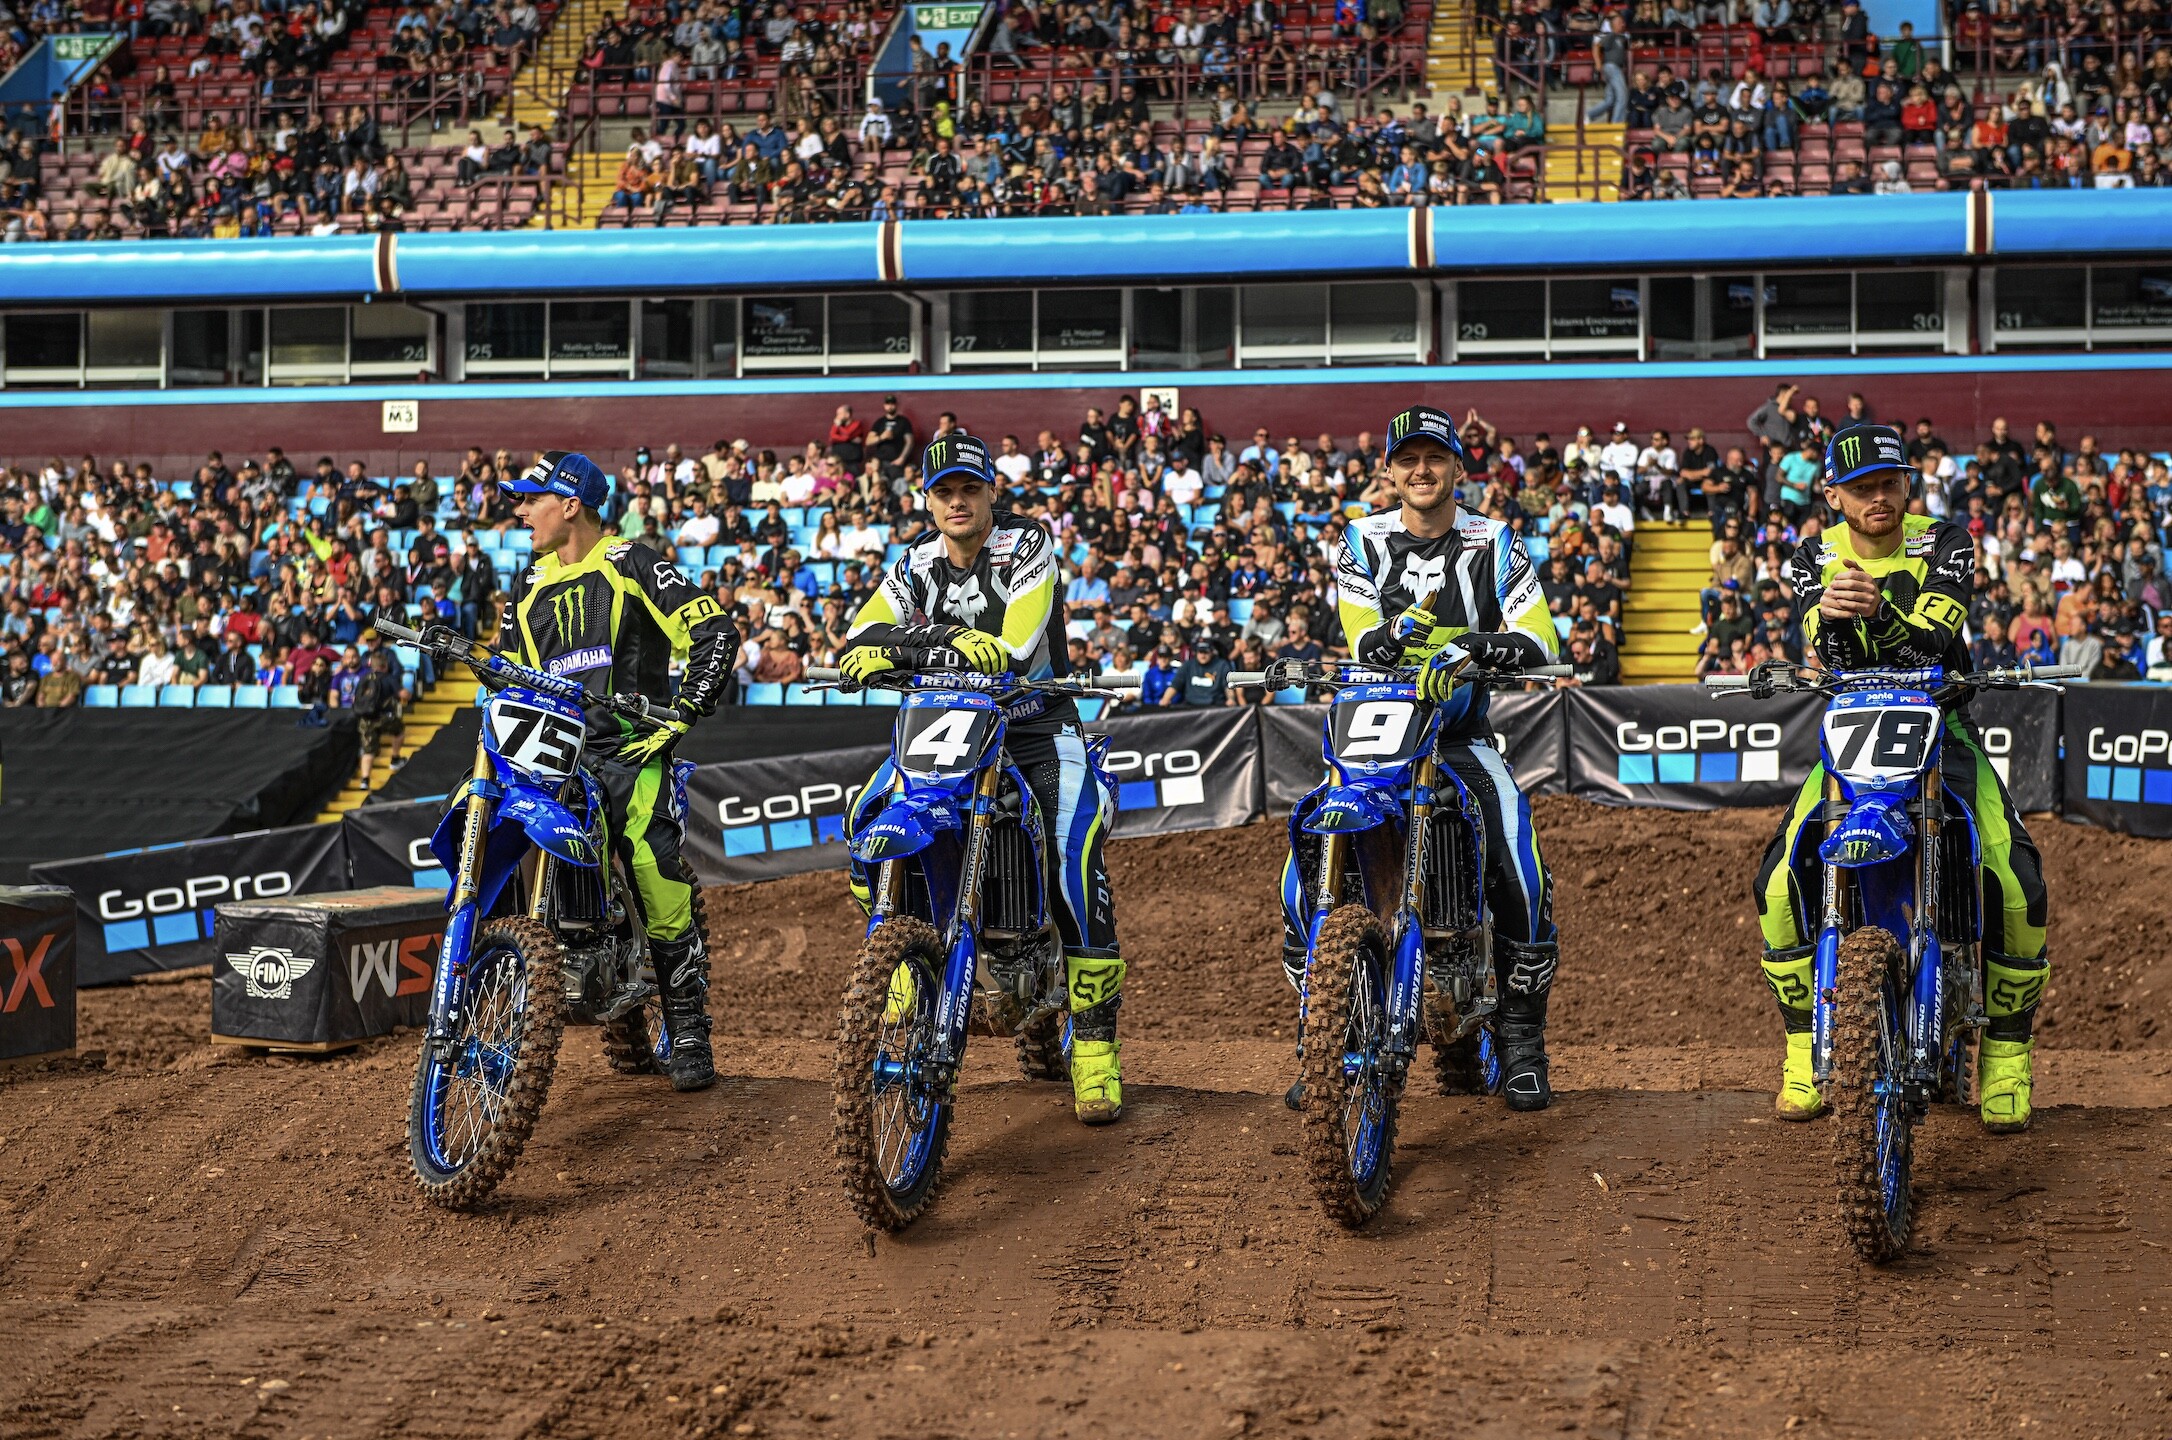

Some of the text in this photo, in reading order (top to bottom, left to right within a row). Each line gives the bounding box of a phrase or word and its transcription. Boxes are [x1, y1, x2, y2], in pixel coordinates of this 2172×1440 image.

[949, 10, 980, 24] EXIT
[1914, 313, 1941, 330] 30
[2000, 312, 2022, 328] 31
[1461, 323, 1487, 340] 29
[469, 343, 494, 359] 25
[885, 337, 909, 352] 26
[953, 336, 977, 351] 27
[402, 345, 426, 361] 24
[1426, 412, 1450, 426] YAMAHA
[962, 443, 985, 456] YAMAHA
[565, 473, 579, 485] FOX
[1465, 527, 1488, 535] YAMAHA
[1911, 535, 1935, 543] YAMAHA
[1462, 538, 1488, 548] YAMALUBE
[1906, 545, 1934, 556] YAMALUBE
[680, 598, 724, 628] FO
[1921, 595, 1964, 626] FO
[954, 626, 986, 647] FOX
[560, 648, 609, 673] YAMAHA
[856, 646, 892, 665] FOX
[926, 649, 971, 672] FO
[920, 674, 1004, 690] RENTHAL
[1348, 670, 1416, 684] RENT
[932, 693, 959, 704] panta
[1366, 686, 1392, 695] panta
[1397, 688, 1417, 697] WS
[1866, 692, 1894, 701] panta
[532, 693, 557, 708] panta
[963, 697, 989, 707] WSX
[1899, 695, 1928, 704] WSX
[560, 705, 581, 719] WSX
[905, 709, 978, 767] 4
[1339, 701, 1415, 758] 9
[1616, 718, 1782, 751] GoPro
[497, 703, 583, 777] 75
[1831, 710, 1933, 770] 78
[2087, 726, 2172, 766] GoP
[1102, 749, 1202, 777] Pro
[717, 782, 863, 826] GoPr
[868, 824, 907, 837] YAMAHA
[1839, 828, 1883, 841] YAMAHA
[99, 869, 293, 922] GoPro
[1095, 868, 1110, 925] FOX
[0, 933, 56, 1014] X
[255, 962, 285, 985] FIM
[349, 932, 444, 1005] WS
[437, 934, 453, 1006] DUNLOP
[956, 955, 974, 1032] DUNLOP
[1409, 947, 1423, 1023] DUNLOP
[1394, 982, 1404, 1017] MINO
[1933, 965, 1944, 1046] DUNLOP
[1918, 1003, 1926, 1041] MINO
